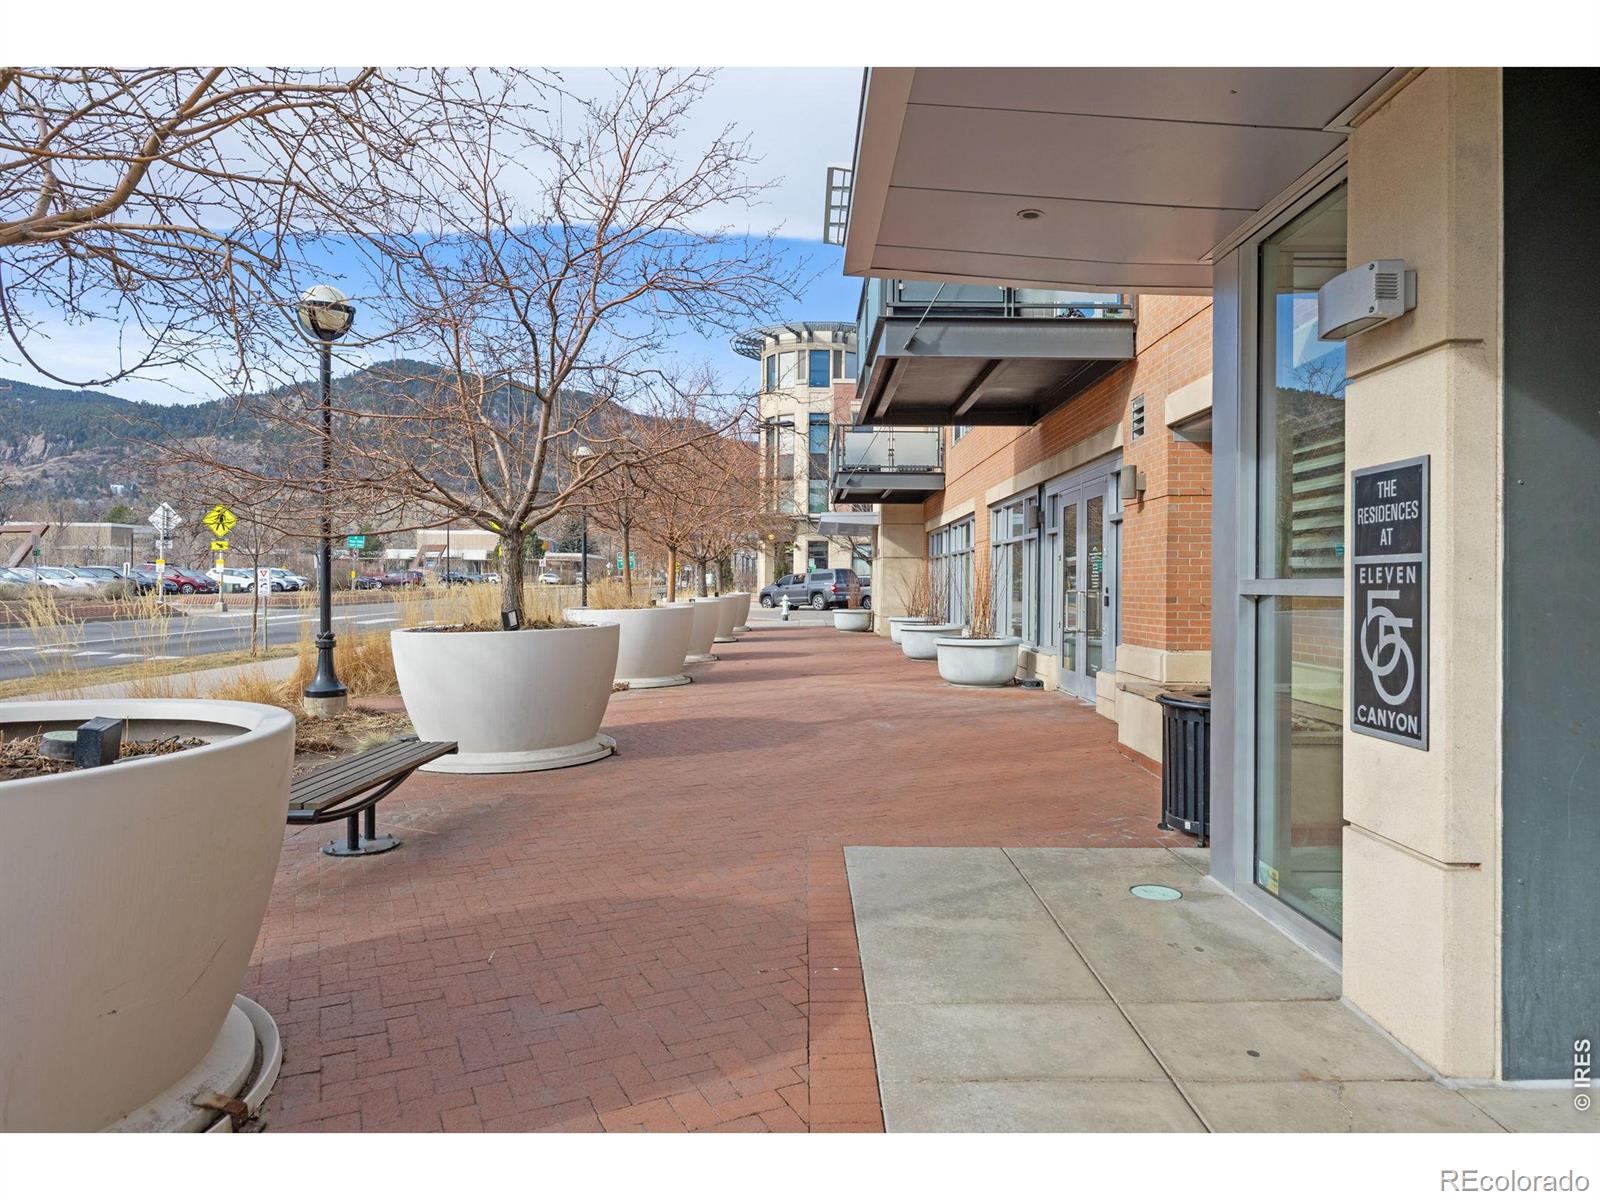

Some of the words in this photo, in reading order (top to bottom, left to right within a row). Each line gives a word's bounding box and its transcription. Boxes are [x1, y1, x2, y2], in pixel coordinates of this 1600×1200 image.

[1377, 479, 1397, 499] THE
[1357, 500, 1419, 525] RESIDENCES
[1380, 527, 1394, 546] AT
[1359, 566, 1417, 584] ELEVEN
[1357, 704, 1418, 735] CANYON
